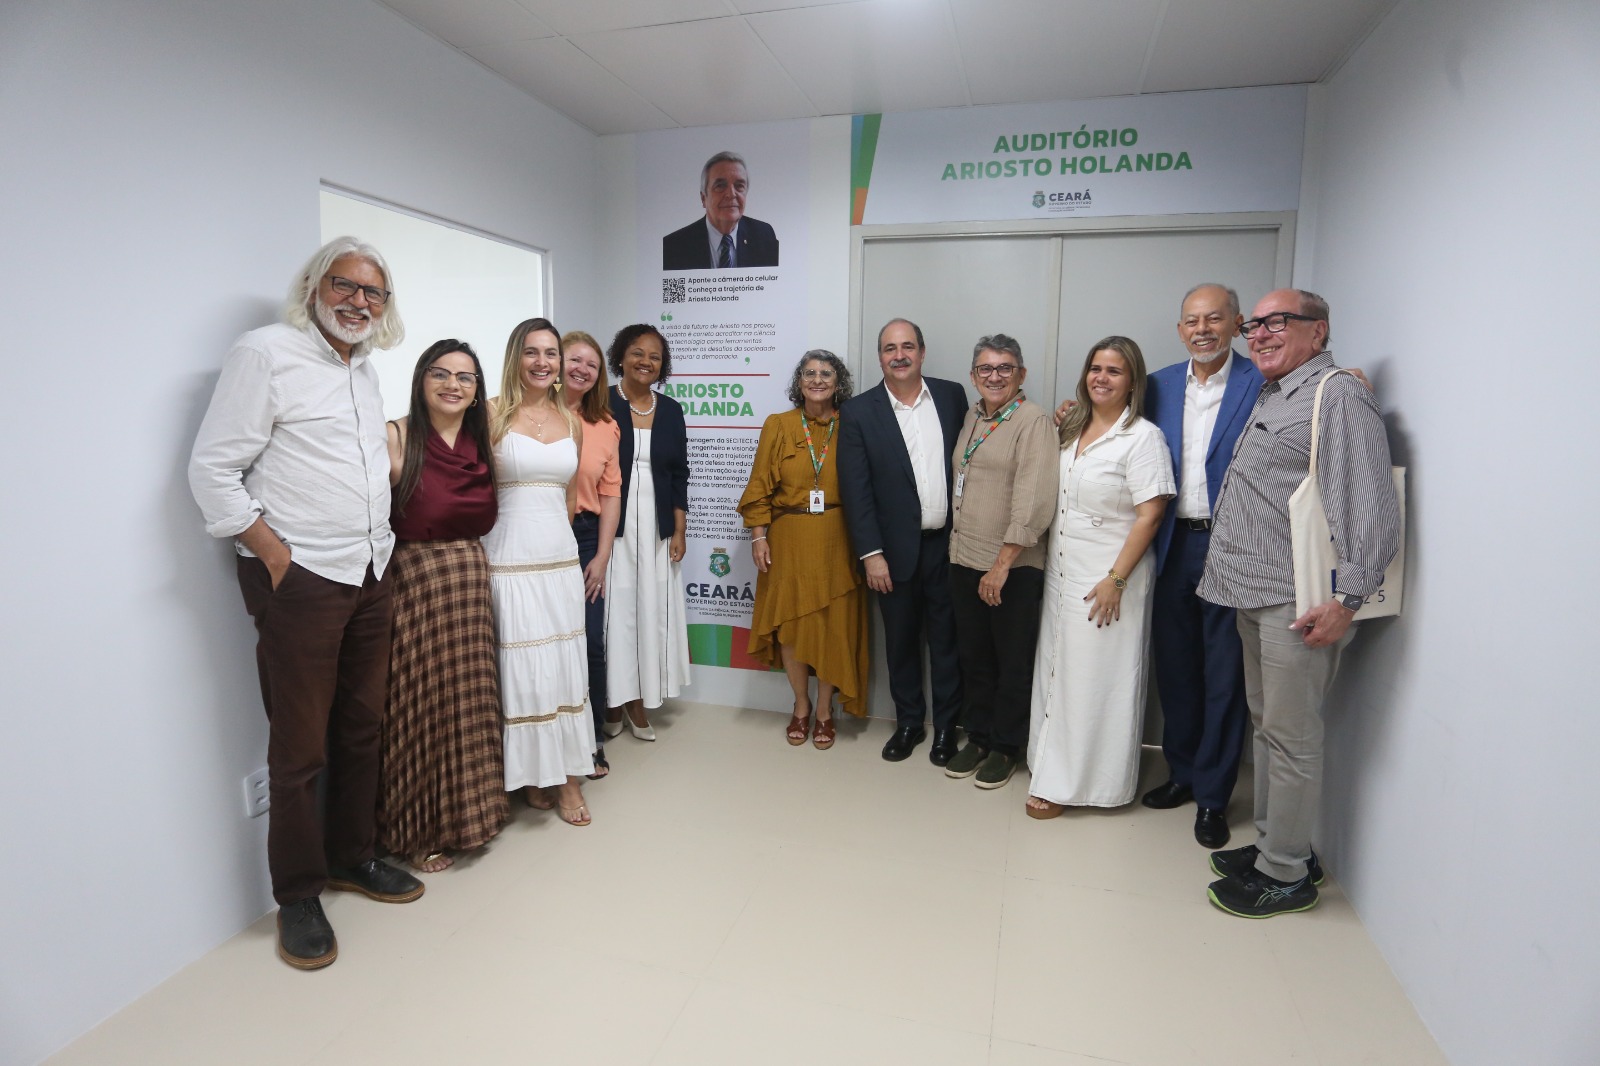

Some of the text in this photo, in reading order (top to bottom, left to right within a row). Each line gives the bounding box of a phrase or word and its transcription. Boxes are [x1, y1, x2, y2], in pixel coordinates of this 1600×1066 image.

[993, 124, 1139, 153] AUDITÓRIO
[941, 151, 1193, 181] ARIOSTO HOLANDA
[1048, 188, 1092, 202] CEARÁ
[724, 284, 754, 294] trajetória
[663, 383, 744, 398] ARIOSTO
[680, 401, 754, 416] OLANDA
[686, 582, 755, 601] CEARÁ
